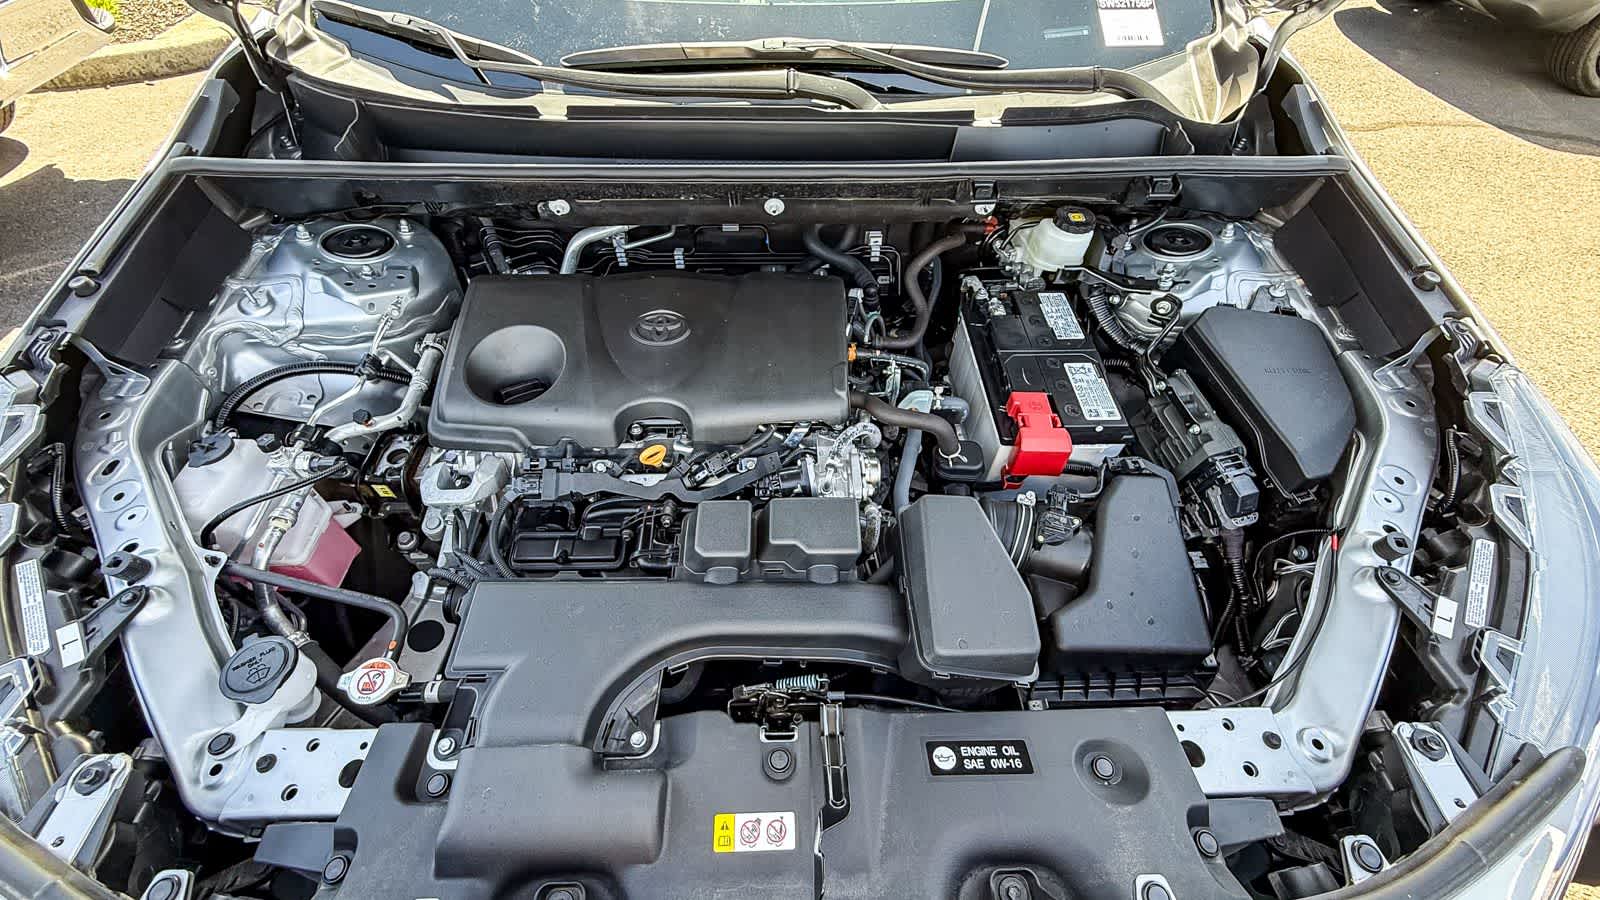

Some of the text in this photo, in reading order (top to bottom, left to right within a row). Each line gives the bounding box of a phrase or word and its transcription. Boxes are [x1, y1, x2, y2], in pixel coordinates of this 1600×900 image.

[960, 745, 1020, 757] ENGINE OIL
[964, 758, 1023, 769] SAE 0W-16
